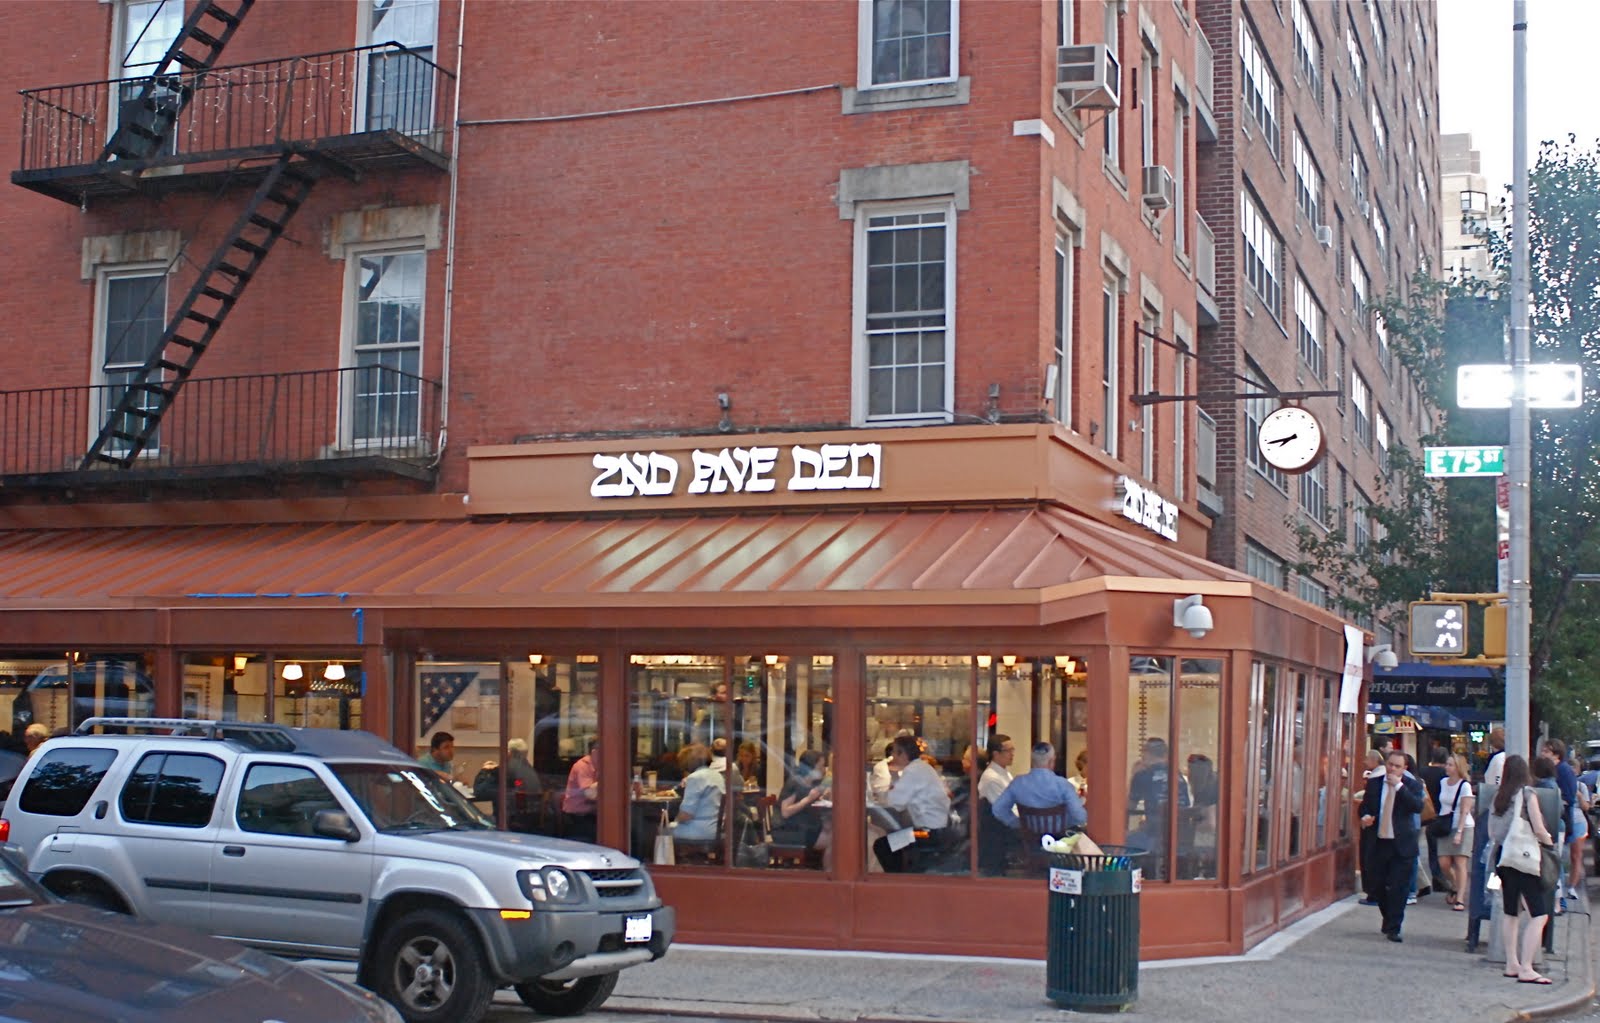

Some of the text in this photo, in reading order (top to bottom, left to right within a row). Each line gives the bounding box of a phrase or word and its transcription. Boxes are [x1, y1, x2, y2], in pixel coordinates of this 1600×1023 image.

[1431, 450, 1501, 473] E 75 ST
[590, 451, 679, 497] 2ND
[1425, 680, 1456, 694] health
[1461, 681, 1489, 700] foods
